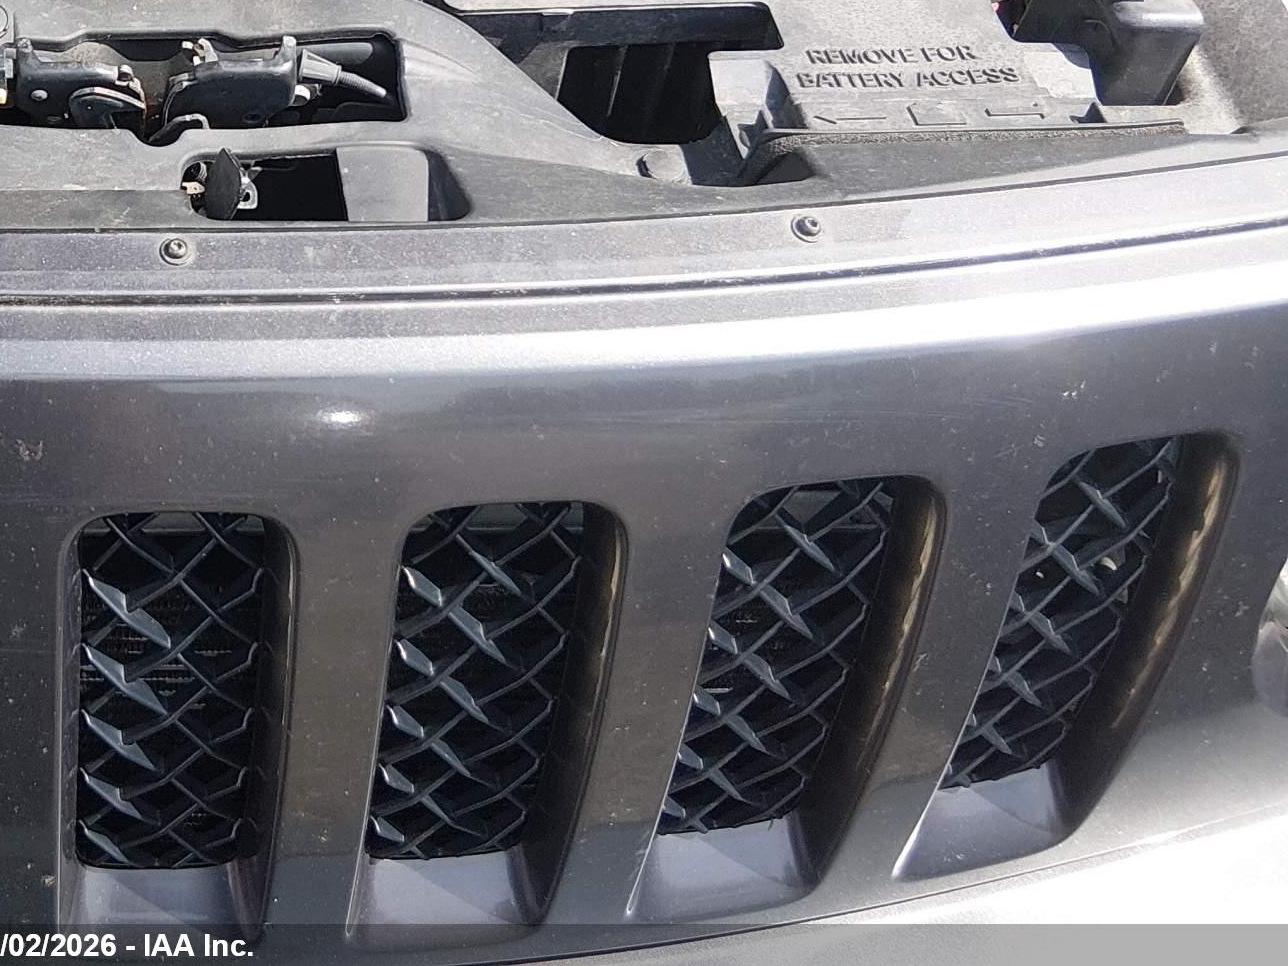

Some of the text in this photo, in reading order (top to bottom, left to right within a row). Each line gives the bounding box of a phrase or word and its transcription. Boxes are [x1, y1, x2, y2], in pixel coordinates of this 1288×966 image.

[805, 44, 980, 65] REMOVE FOR
[795, 66, 1021, 89] BATTERY ACCESS
